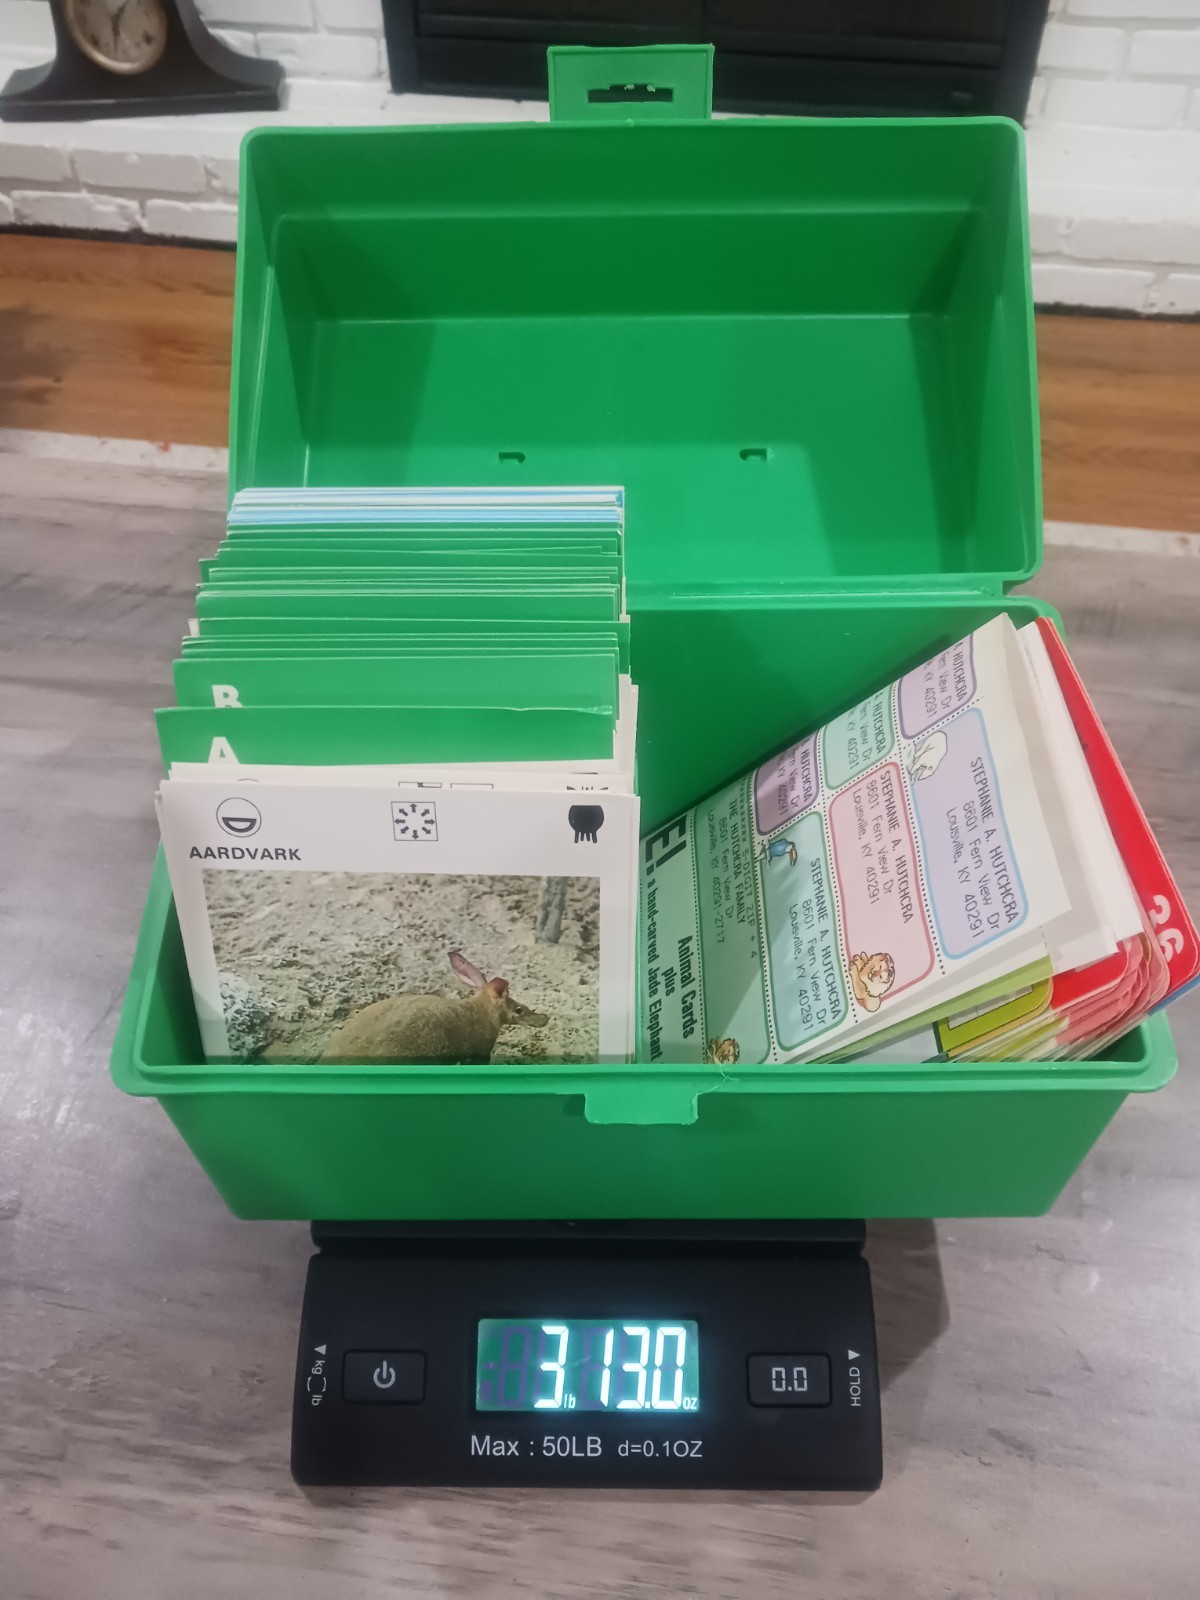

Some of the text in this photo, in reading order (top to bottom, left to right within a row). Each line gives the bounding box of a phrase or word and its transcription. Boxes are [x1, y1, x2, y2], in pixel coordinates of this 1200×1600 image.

[953, 651, 967, 702] HUTCHCRA
[212, 684, 244, 708] B
[924, 688, 938, 718] 40291
[941, 696, 952, 709] Dr
[872, 701, 886, 754] HUTCHCRA
[208, 736, 240, 764] A
[848, 738, 859, 770] 40291
[862, 748, 872, 761] Dr
[801, 748, 812, 802] HUTCHCRA
[778, 784, 788, 816] 40291
[791, 794, 799, 808] Dr
[189, 846, 302, 861] AARDVARK
[853, 788, 880, 905] Louisville, KY 40291
[866, 780, 894, 894] 8601 Fern View Dr
[880, 770, 914, 924] STEPHANIE A. HUTCHCRA
[970, 756, 1020, 924] STEPHANIE A. HUTCHCRA
[722, 848, 730, 872] Fern
[729, 798, 746, 924] THE HUTCHCRA FAMILY
[946, 806, 984, 938] Louisville, KY 40291
[963, 800, 1000, 930] 8601 Fern View Dr
[723, 875, 732, 901] View
[713, 877, 724, 943] 40291-2717
[726, 906, 734, 918] Dr
[746, 904, 755, 926] ZIP
[811, 858, 842, 1020] STEPHANIE A. HUTCHCRA
[647, 878, 664, 1062] a hand-carved Jade Elephant
[789, 904, 814, 1031] Louisville, KY 40291
[802, 898, 826, 1024] 8601 Fern View Dr
[661, 966, 678, 996] plus
[678, 935, 698, 1040] Animal Cards
[312, 1360, 325, 1374] kg
[533, 1326, 698, 1410] 3 lb 13.0 oz
[772, 1367, 808, 1392] 0.0
[312, 1394, 322, 1406] lb
[849, 1366, 862, 1407] HOLD
[470, 1434, 520, 1457] Max
[542, 1436, 602, 1458] 50LB
